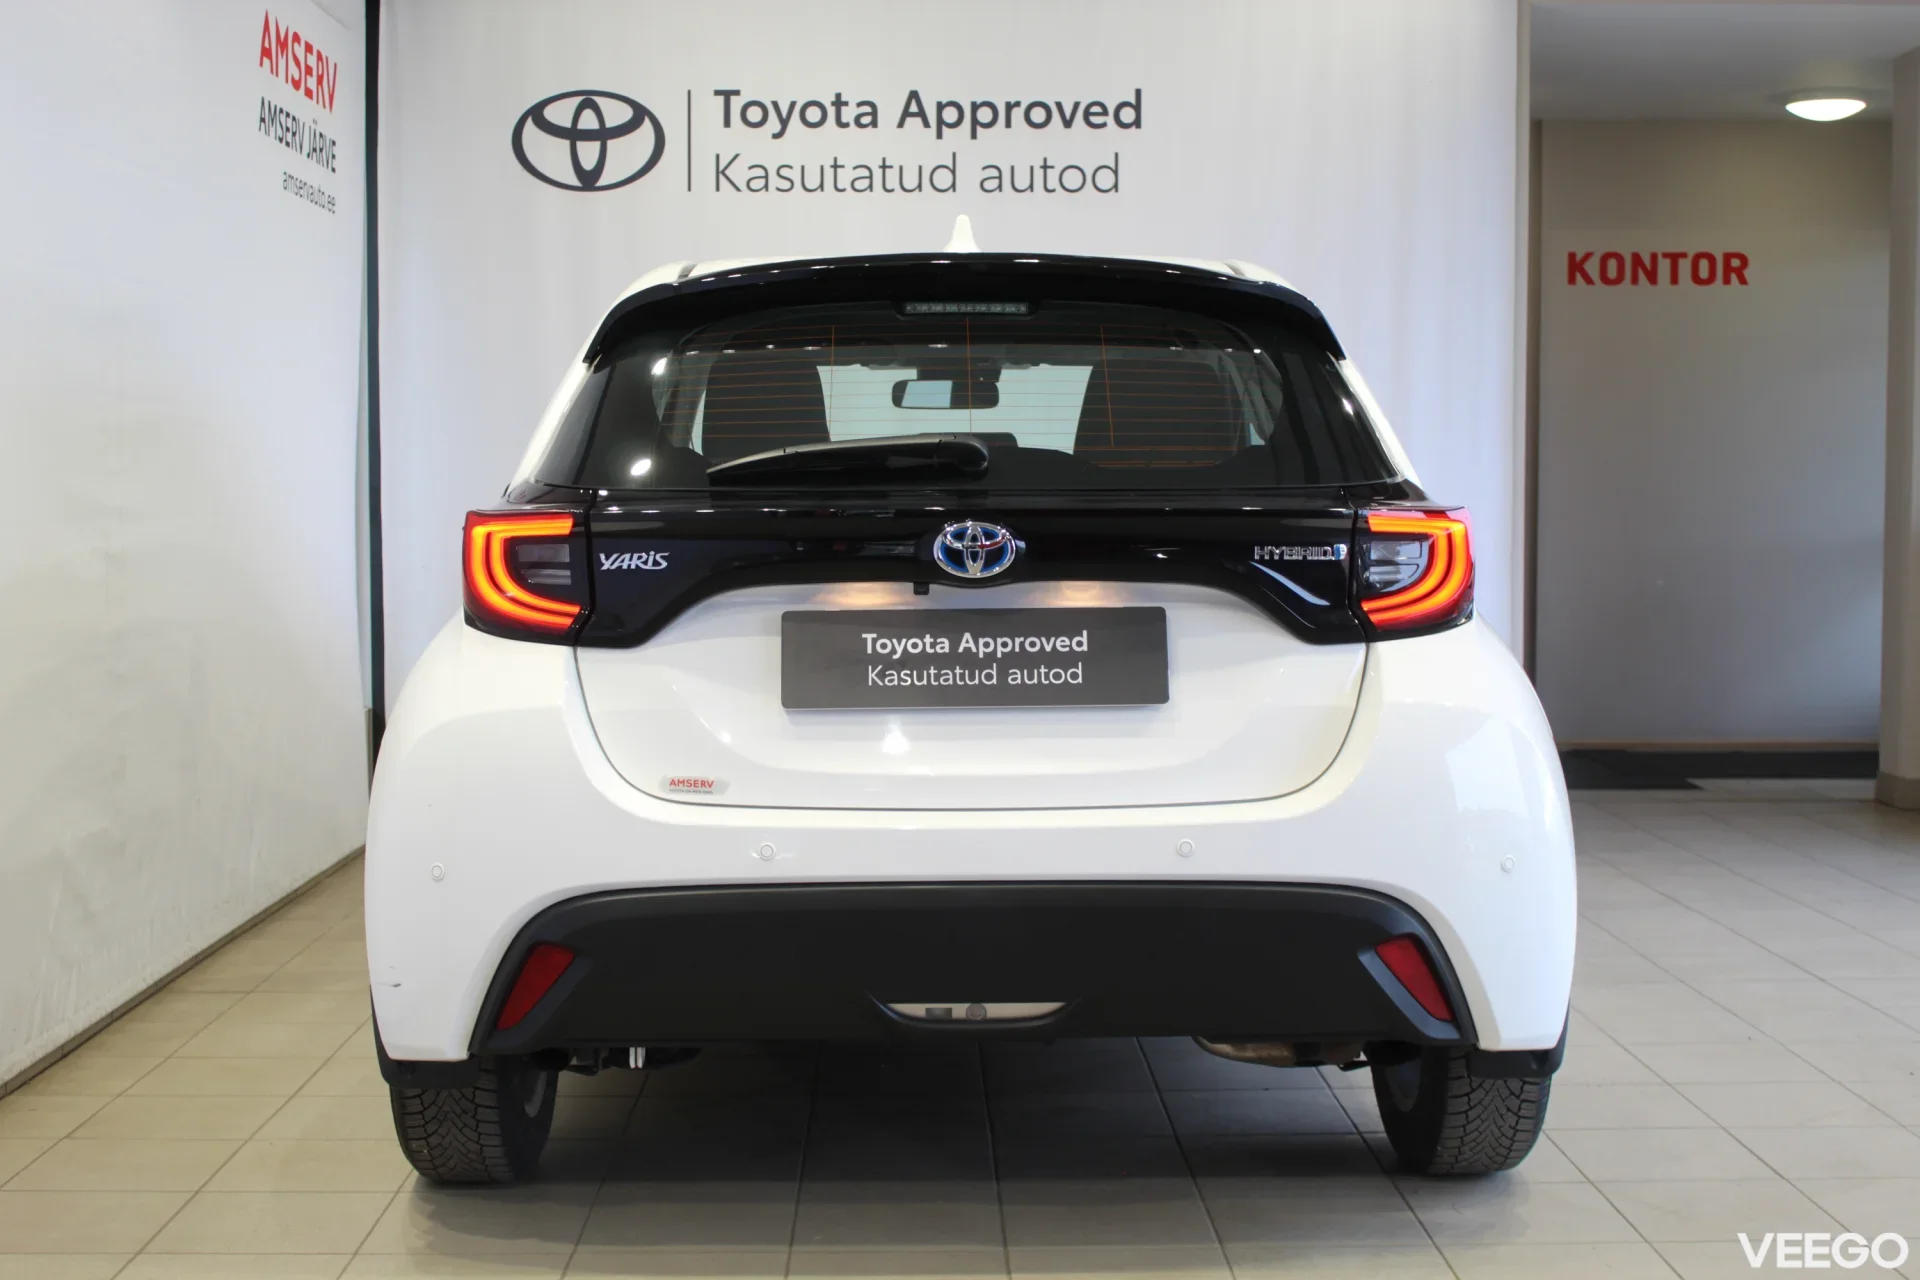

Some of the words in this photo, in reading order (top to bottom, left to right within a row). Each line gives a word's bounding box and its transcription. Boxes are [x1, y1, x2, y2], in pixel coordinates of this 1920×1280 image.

[259, 8, 338, 115] AMSERV
[713, 88, 880, 140] Toyota
[896, 88, 1144, 140] Approved
[258, 96, 305, 156] AMSERV
[306, 118, 337, 174] JÄRVE
[714, 151, 959, 194] Kasutatud
[979, 151, 1121, 194] autod
[282, 170, 337, 215] amservauto.ee
[1567, 251, 1750, 287] KONTOR
[1254, 545, 1335, 561] HYBRID
[861, 633, 950, 660] Toyota
[957, 629, 1089, 659] Approved
[867, 662, 998, 687] Kasutatud
[1007, 661, 1084, 685] autod
[669, 778, 715, 789] AMSERV
